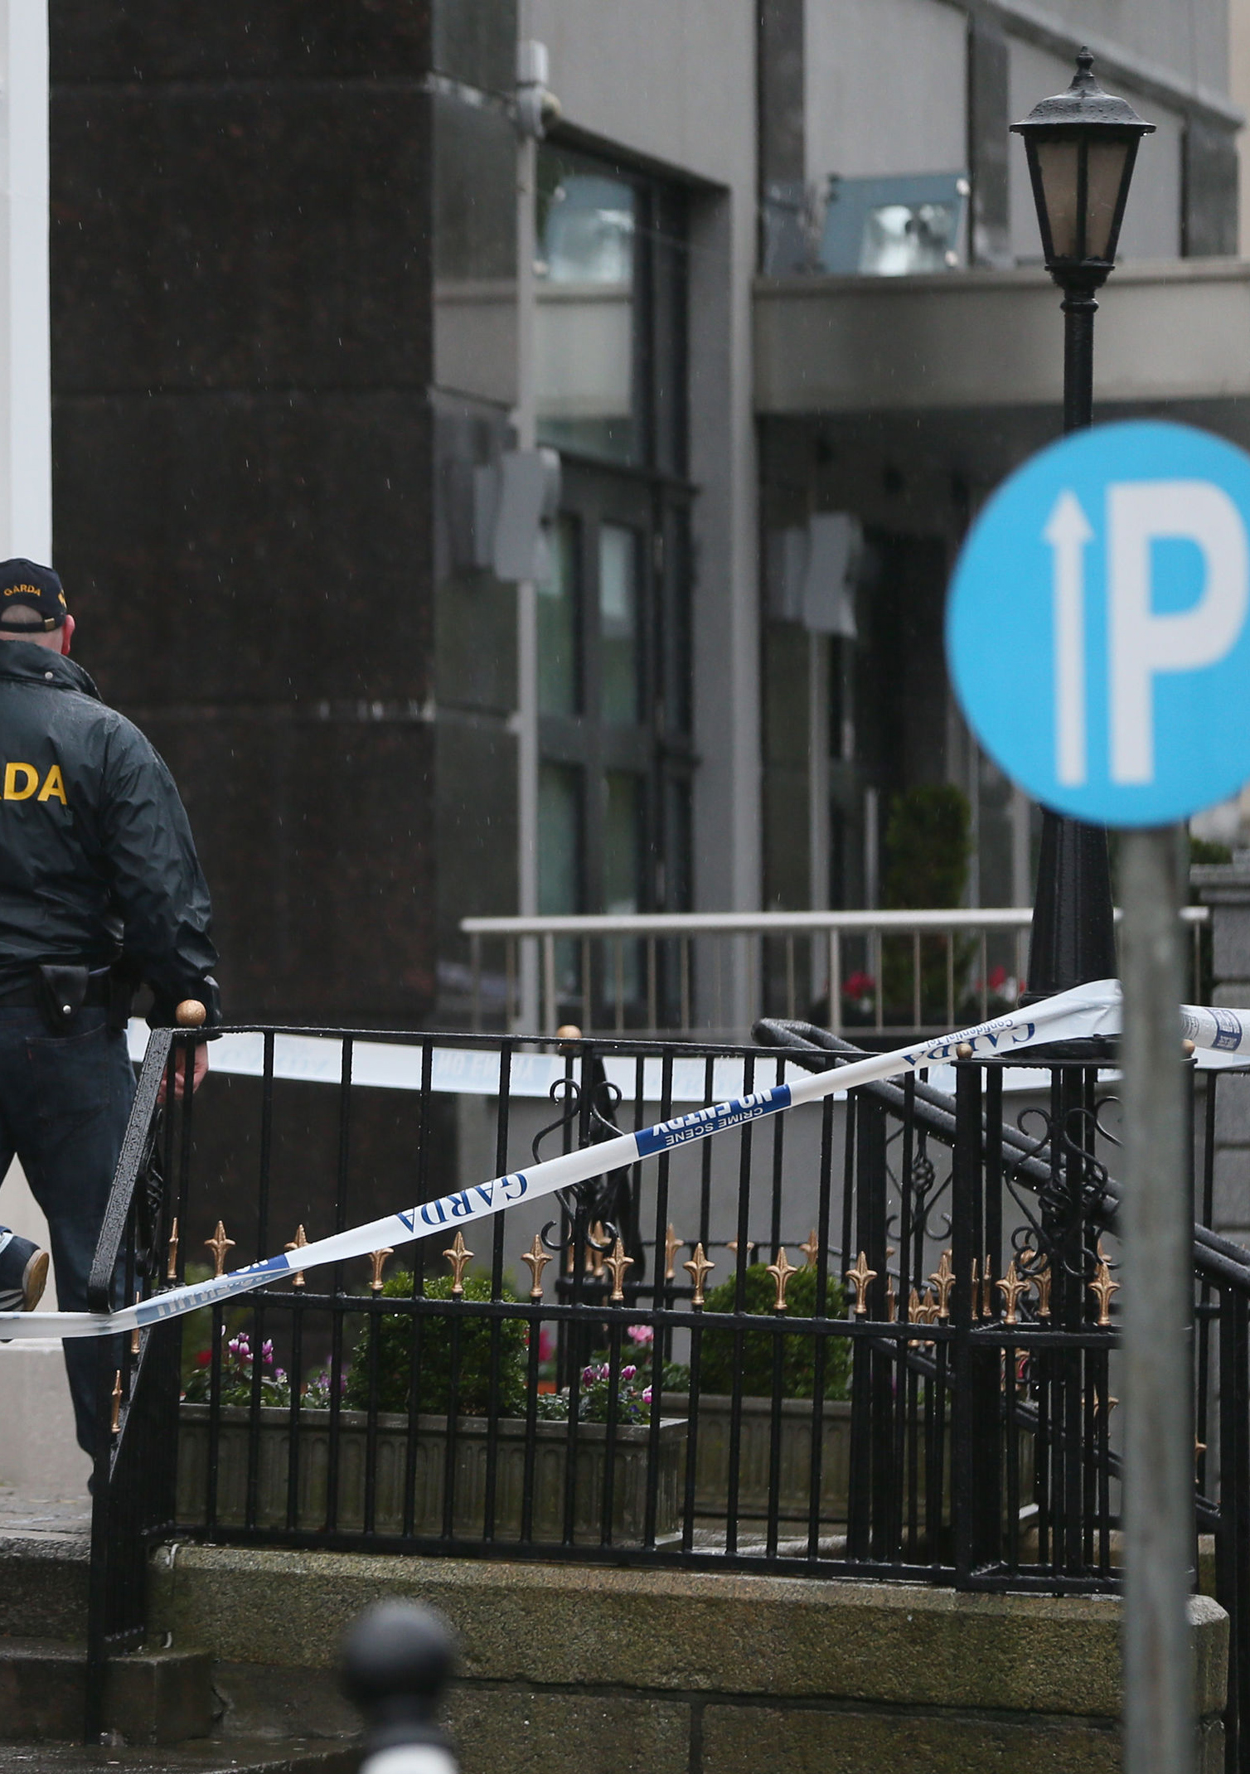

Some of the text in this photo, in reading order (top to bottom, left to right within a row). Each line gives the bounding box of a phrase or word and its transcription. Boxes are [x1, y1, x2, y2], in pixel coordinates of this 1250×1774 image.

[3, 583, 42, 597] GARDA
[1105, 479, 1249, 785] P
[665, 1106, 764, 1146] CRIME SCENE
[396, 1173, 528, 1233] GARDA
